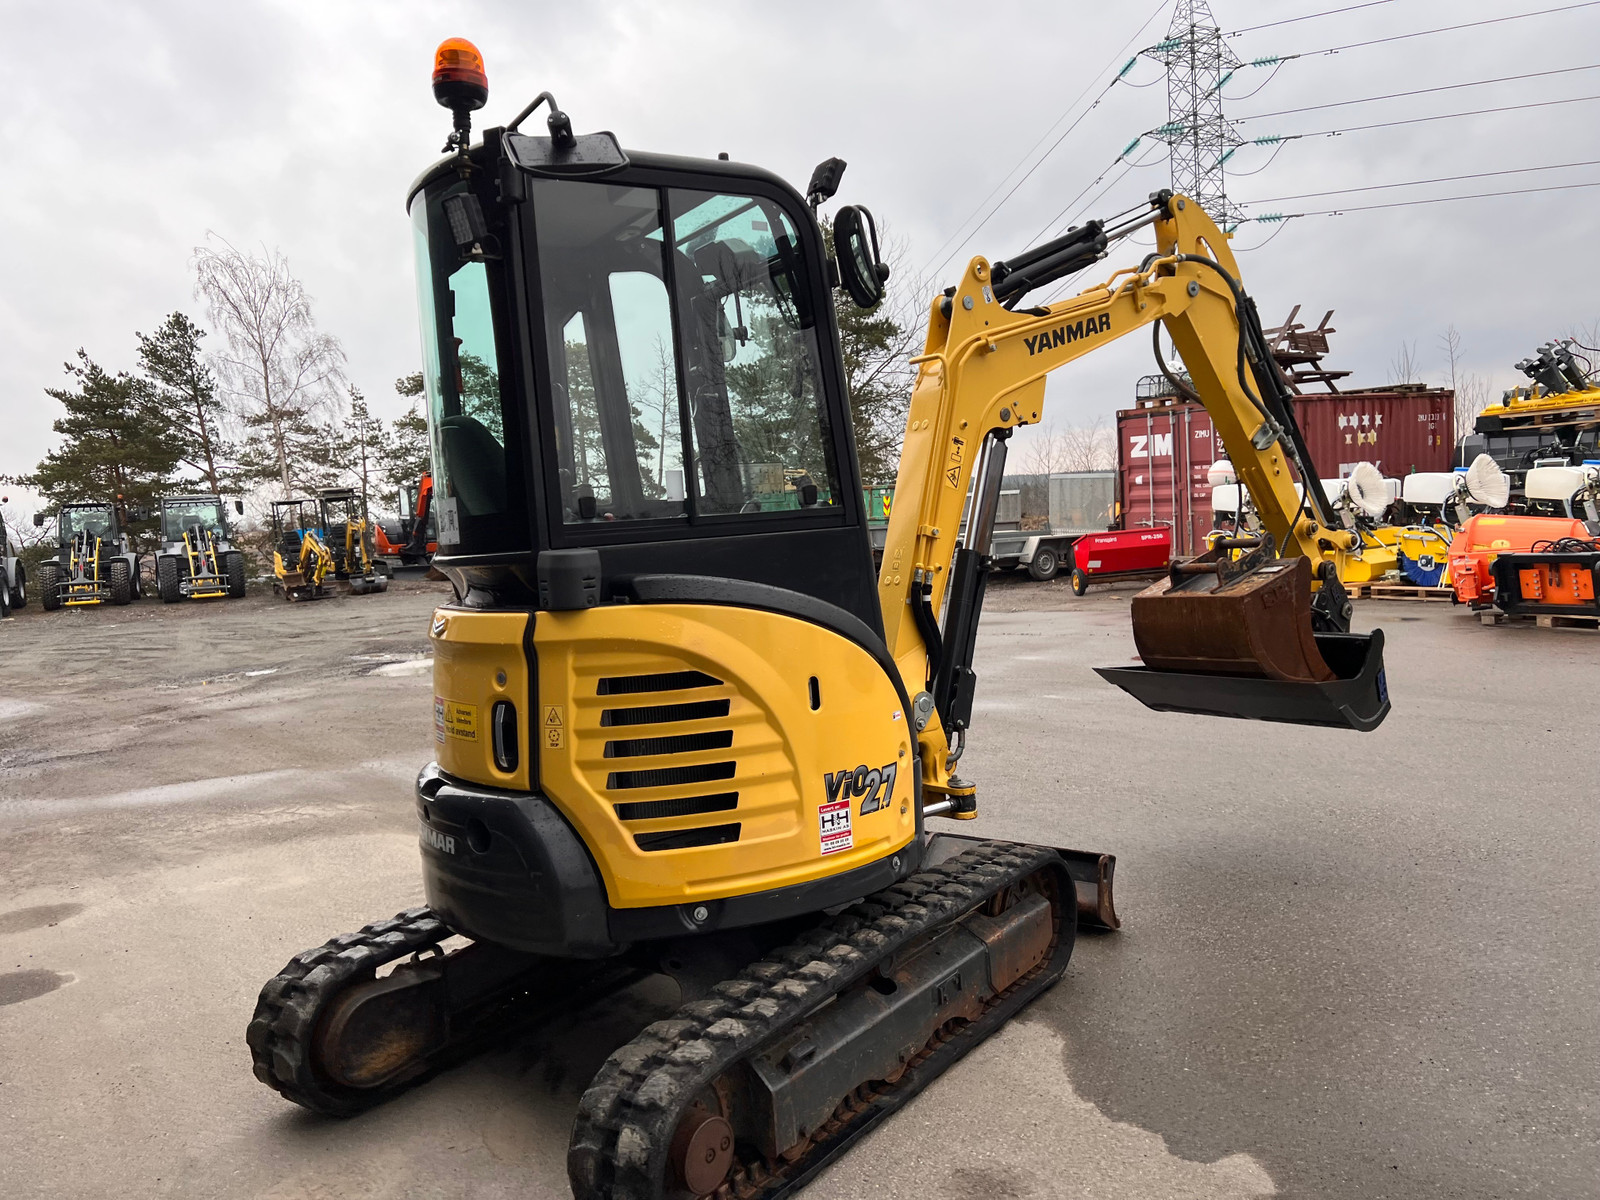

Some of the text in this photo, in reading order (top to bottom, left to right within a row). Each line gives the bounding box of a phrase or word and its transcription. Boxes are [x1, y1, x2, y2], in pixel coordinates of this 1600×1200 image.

[1023, 312, 1111, 356] YANMAR
[1129, 432, 1173, 459] ZIM
[1194, 429, 1210, 439] ZIMU
